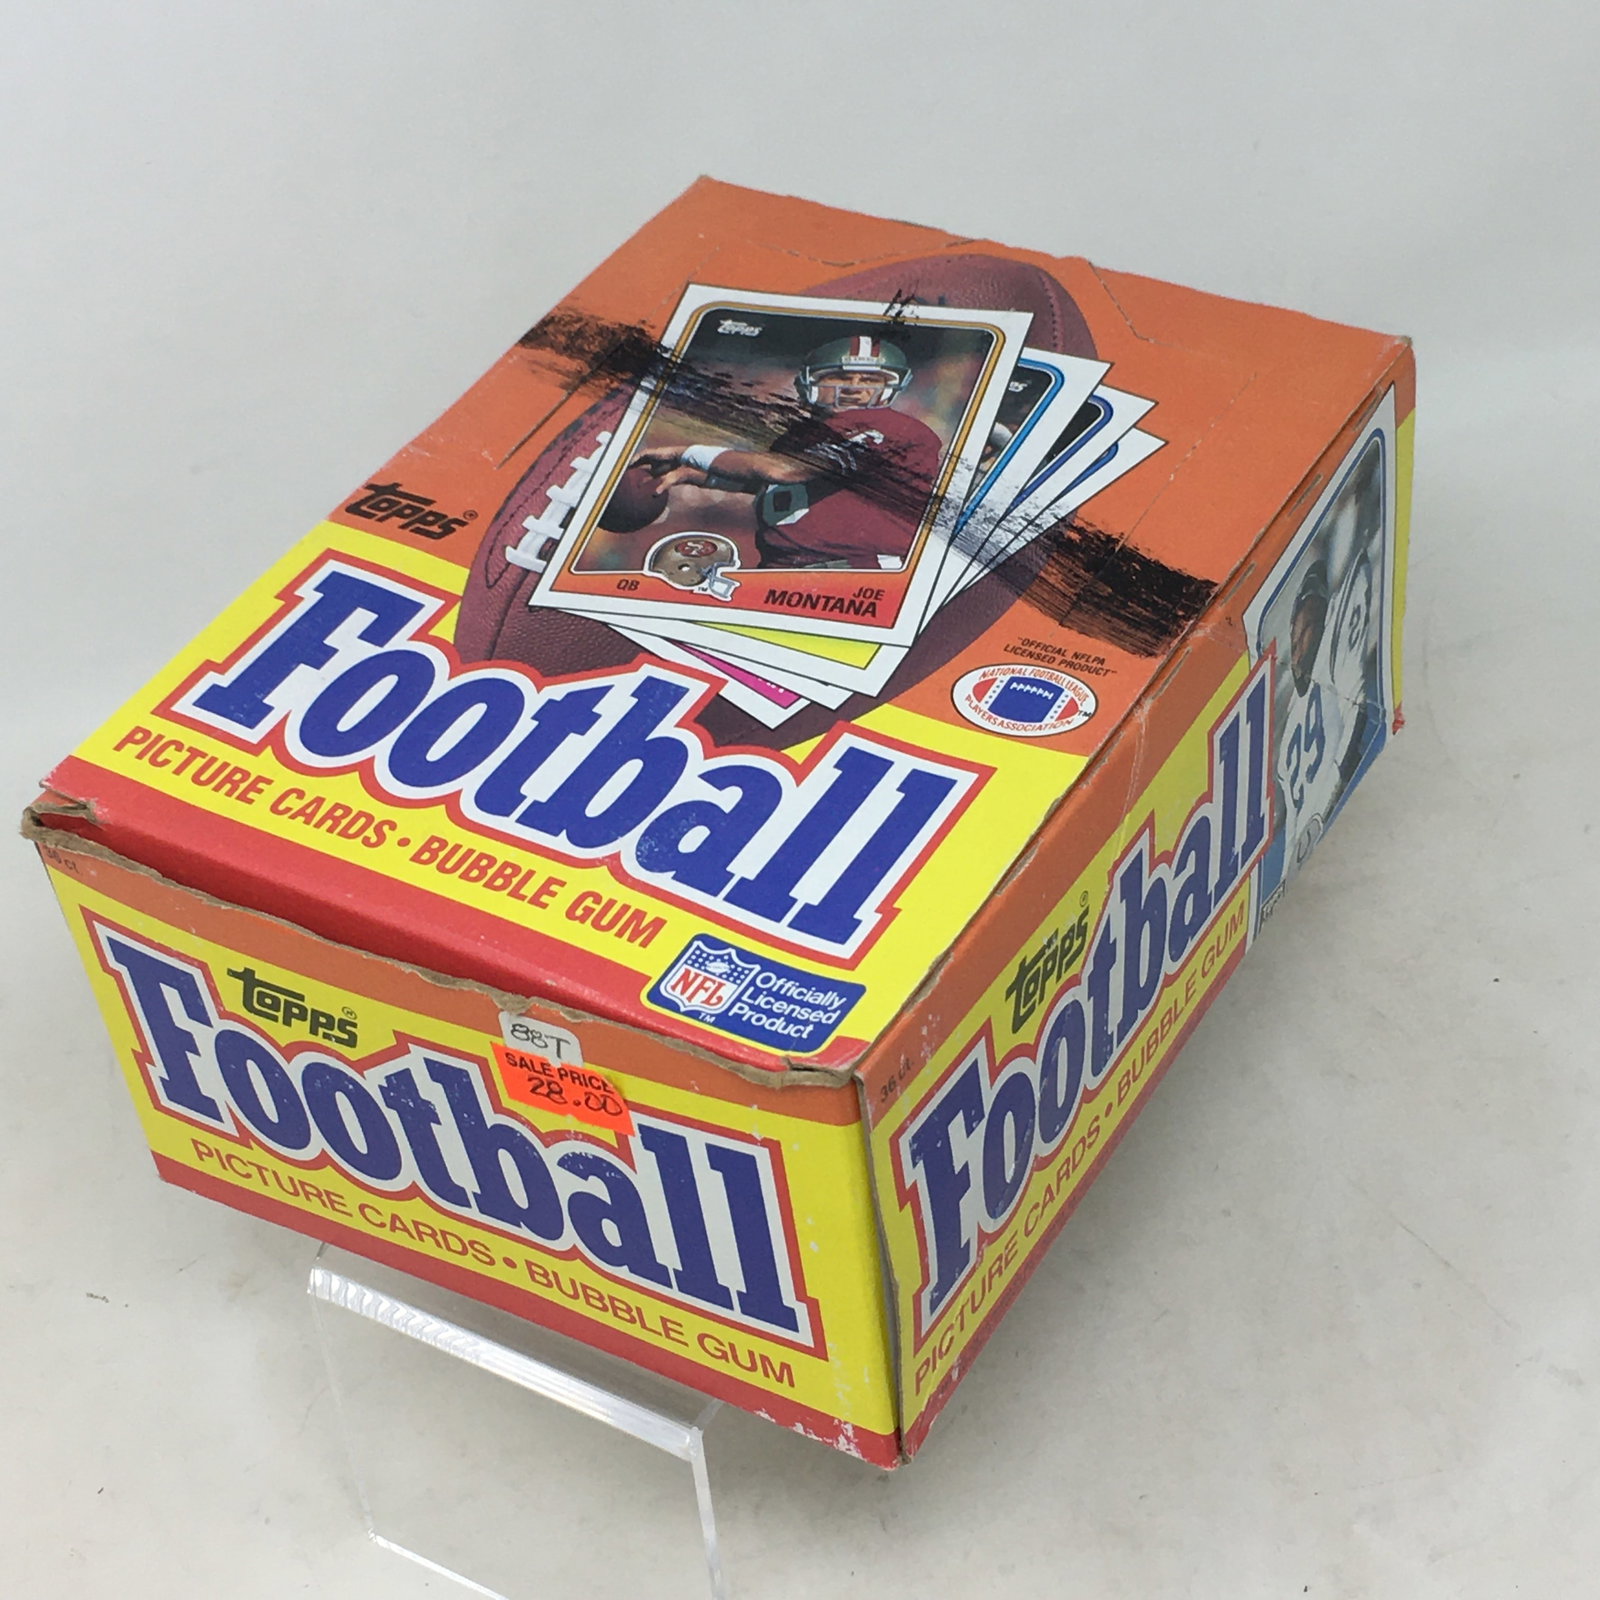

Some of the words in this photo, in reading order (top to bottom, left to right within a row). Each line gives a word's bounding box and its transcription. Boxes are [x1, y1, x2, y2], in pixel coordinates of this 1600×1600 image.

[616, 579, 640, 591] QB
[764, 588, 878, 618] MONTANA
[853, 586, 886, 601] JOE
[1003, 644, 1057, 664] LICENSED
[1072, 650, 1106, 666] NFLPA
[979, 666, 1028, 681] NATIONAL
[1028, 668, 1066, 687] FOOTBALL
[1064, 679, 1091, 707] LEAGUE
[965, 692, 998, 726] PLAYERS
[996, 717, 1076, 732] ASSOCIATION
[192, 570, 959, 944] Football
[112, 724, 274, 804] PICTURE
[269, 787, 398, 850] CARDS
[409, 834, 567, 911] BUBBLE
[564, 889, 668, 949] GUM
[670, 967, 724, 1007] NFL
[741, 986, 841, 1025] Licensed
[755, 971, 847, 1011] Officially
[908, 664, 1268, 1316] Football
[698, 1012, 716, 1023] TM
[728, 1002, 814, 1039] Product
[510, 1023, 571, 1059] 88T
[504, 1052, 554, 1078] SALE
[557, 1067, 615, 1095] PRICE
[526, 1076, 623, 1117] 28.00
[105, 935, 800, 1333] Football
[914, 1238, 1020, 1396] PICTURE
[1023, 1124, 1101, 1232] CARDS
[1116, 972, 1197, 1107] BUBBLE
[1200, 898, 1246, 980] GUM
[191, 1138, 353, 1218] PICTURE
[358, 1202, 498, 1267] CARDS
[527, 1258, 689, 1346] BUBBLE
[696, 1332, 796, 1388] GUM
